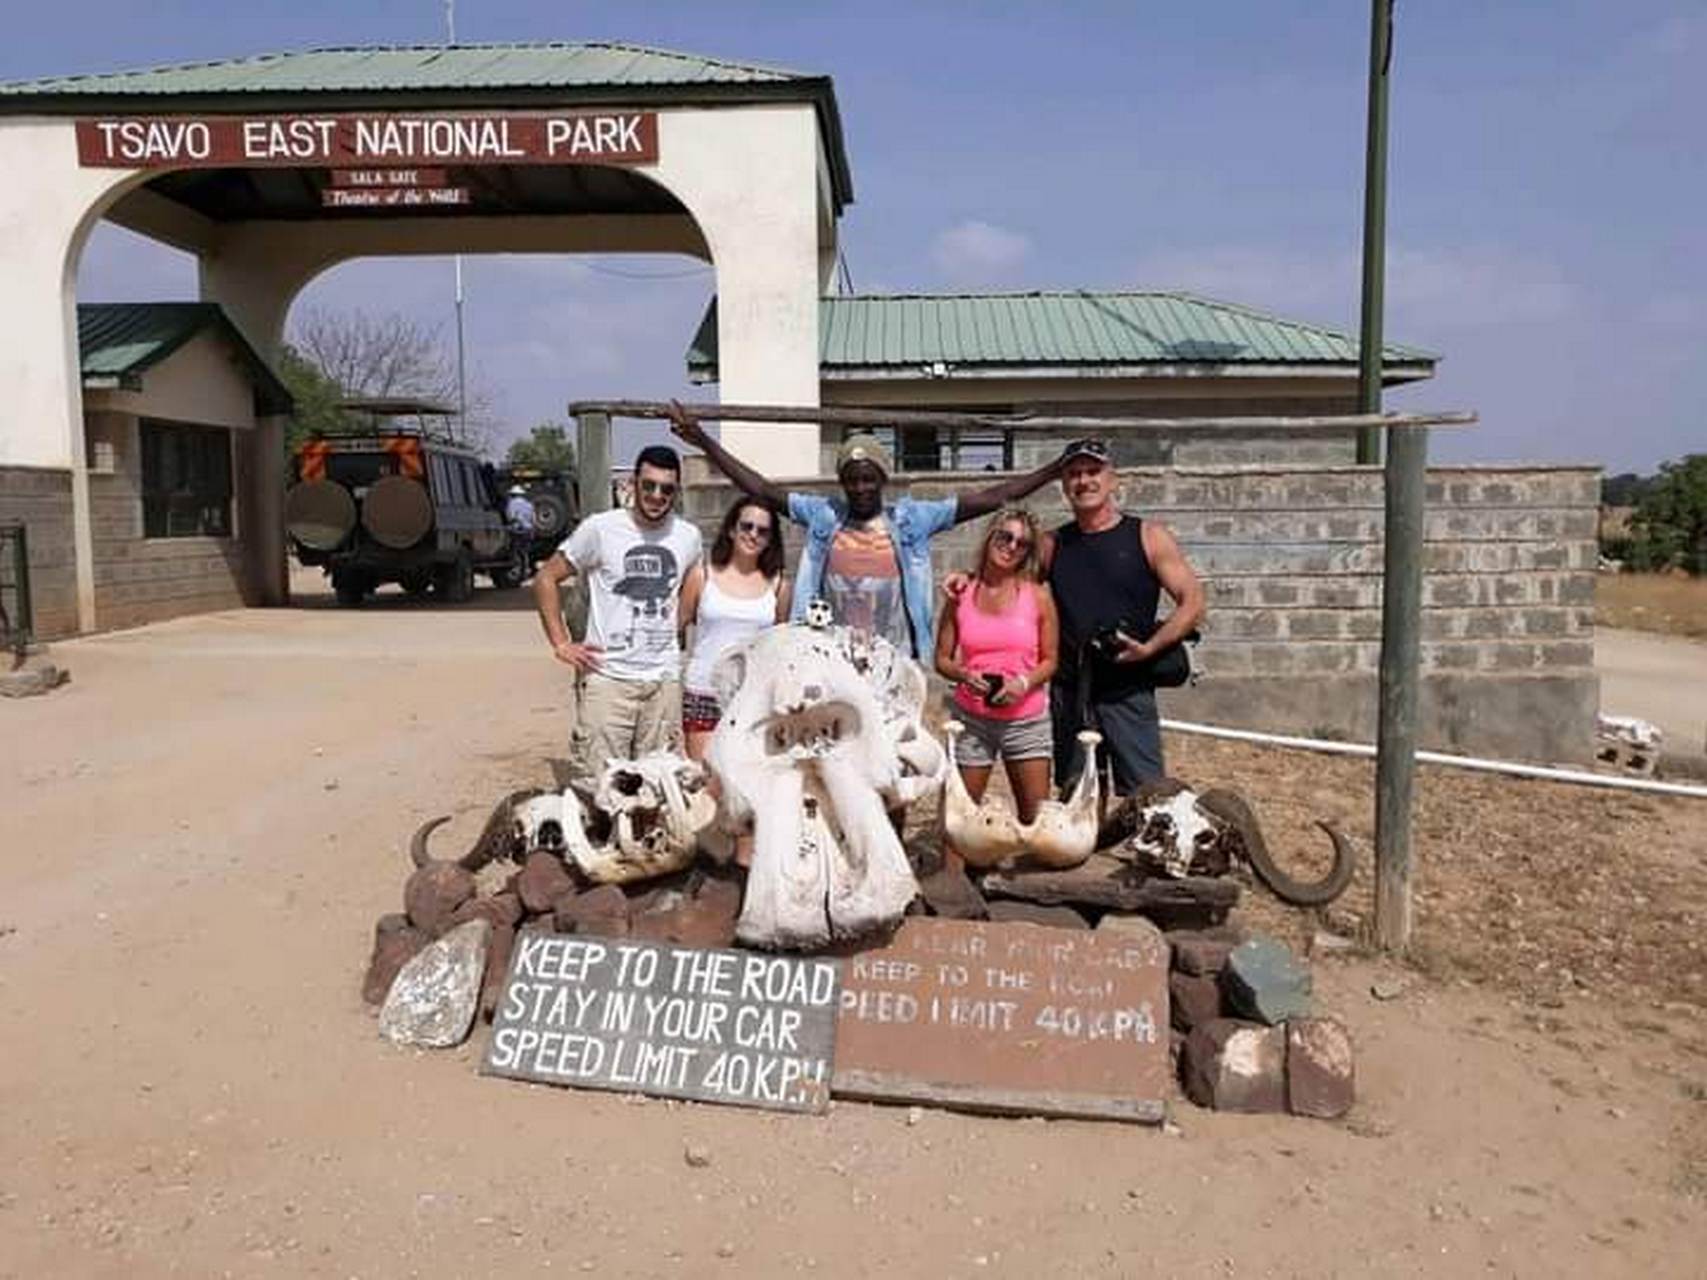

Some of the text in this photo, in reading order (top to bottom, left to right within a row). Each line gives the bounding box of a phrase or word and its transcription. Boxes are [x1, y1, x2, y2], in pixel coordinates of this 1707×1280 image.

[98, 116, 642, 159] TSAVO EAST NATIONAL PARK
[514, 937, 835, 1006] KEEP TO THE ROAD
[853, 959, 921, 982] KEEP
[939, 966, 968, 988] TO
[984, 968, 1034, 991] THE
[503, 982, 801, 1050] STAY IN YOUR CAR
[491, 1028, 604, 1077] SPEED
[609, 1039, 699, 1090] LIMIT
